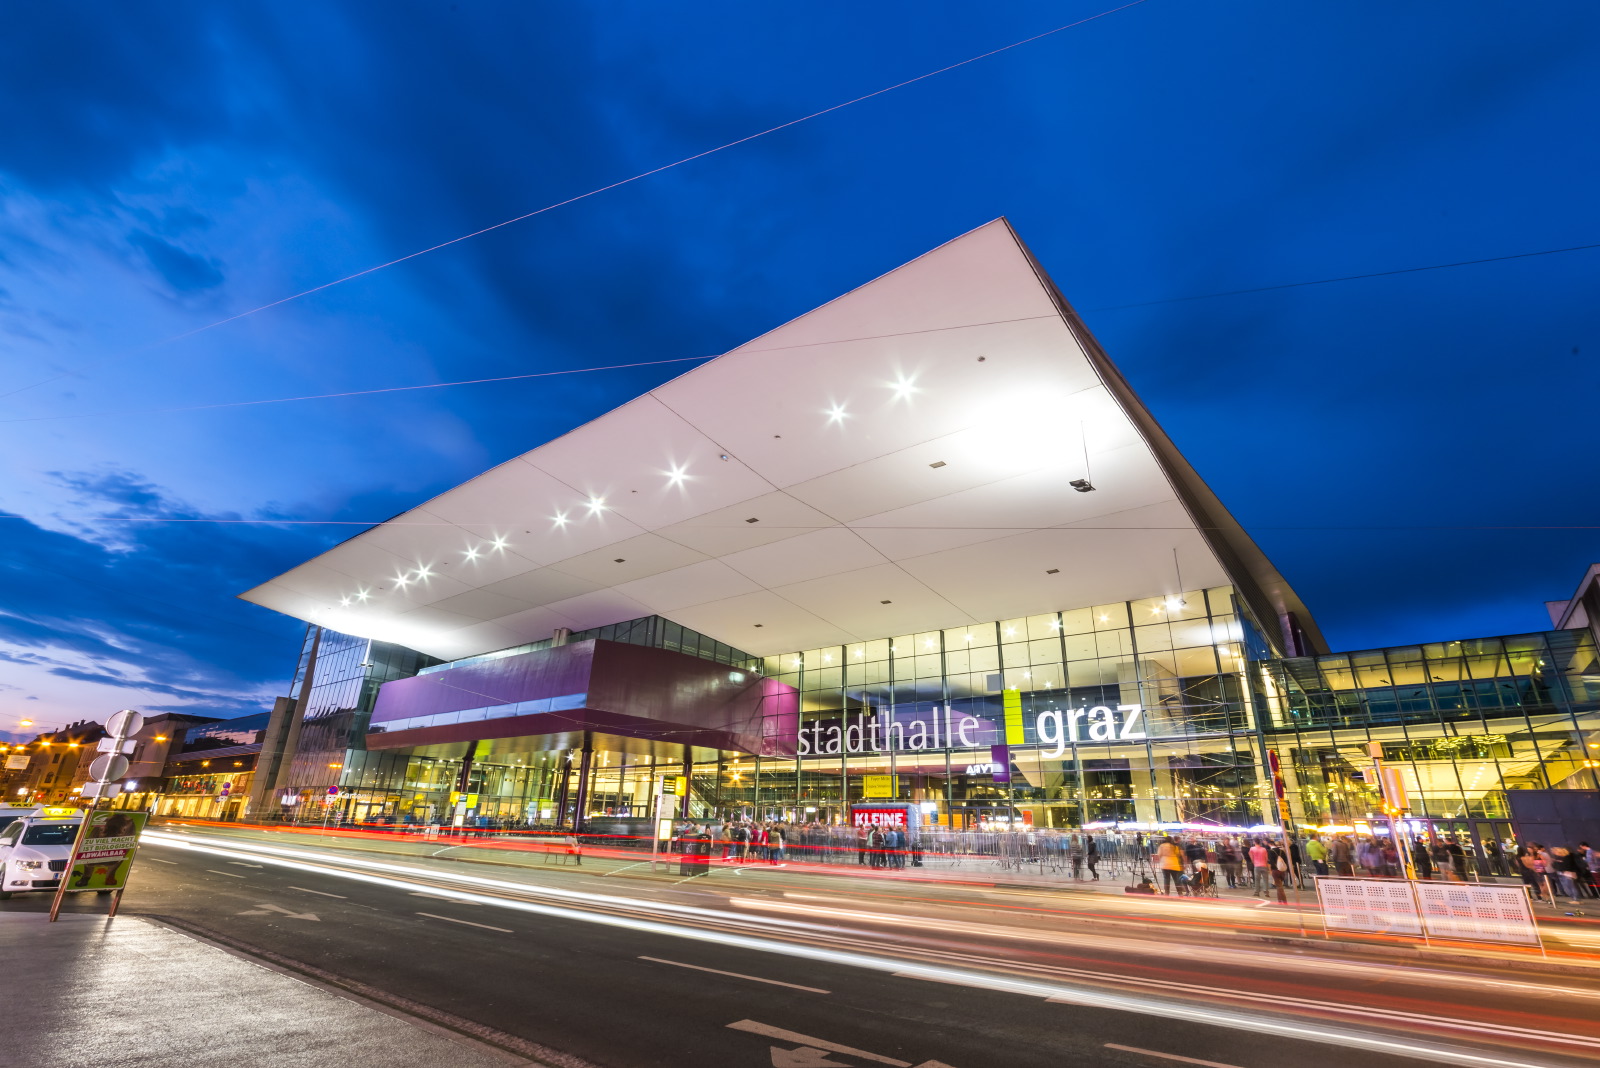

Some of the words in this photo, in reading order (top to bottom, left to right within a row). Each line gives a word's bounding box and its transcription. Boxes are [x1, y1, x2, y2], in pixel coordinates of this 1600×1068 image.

[797, 705, 980, 755] stadthalle
[1037, 703, 1146, 759] graz
[854, 812, 904, 827] KLEINE
[95, 842, 135, 851] BIOLOGISCH
